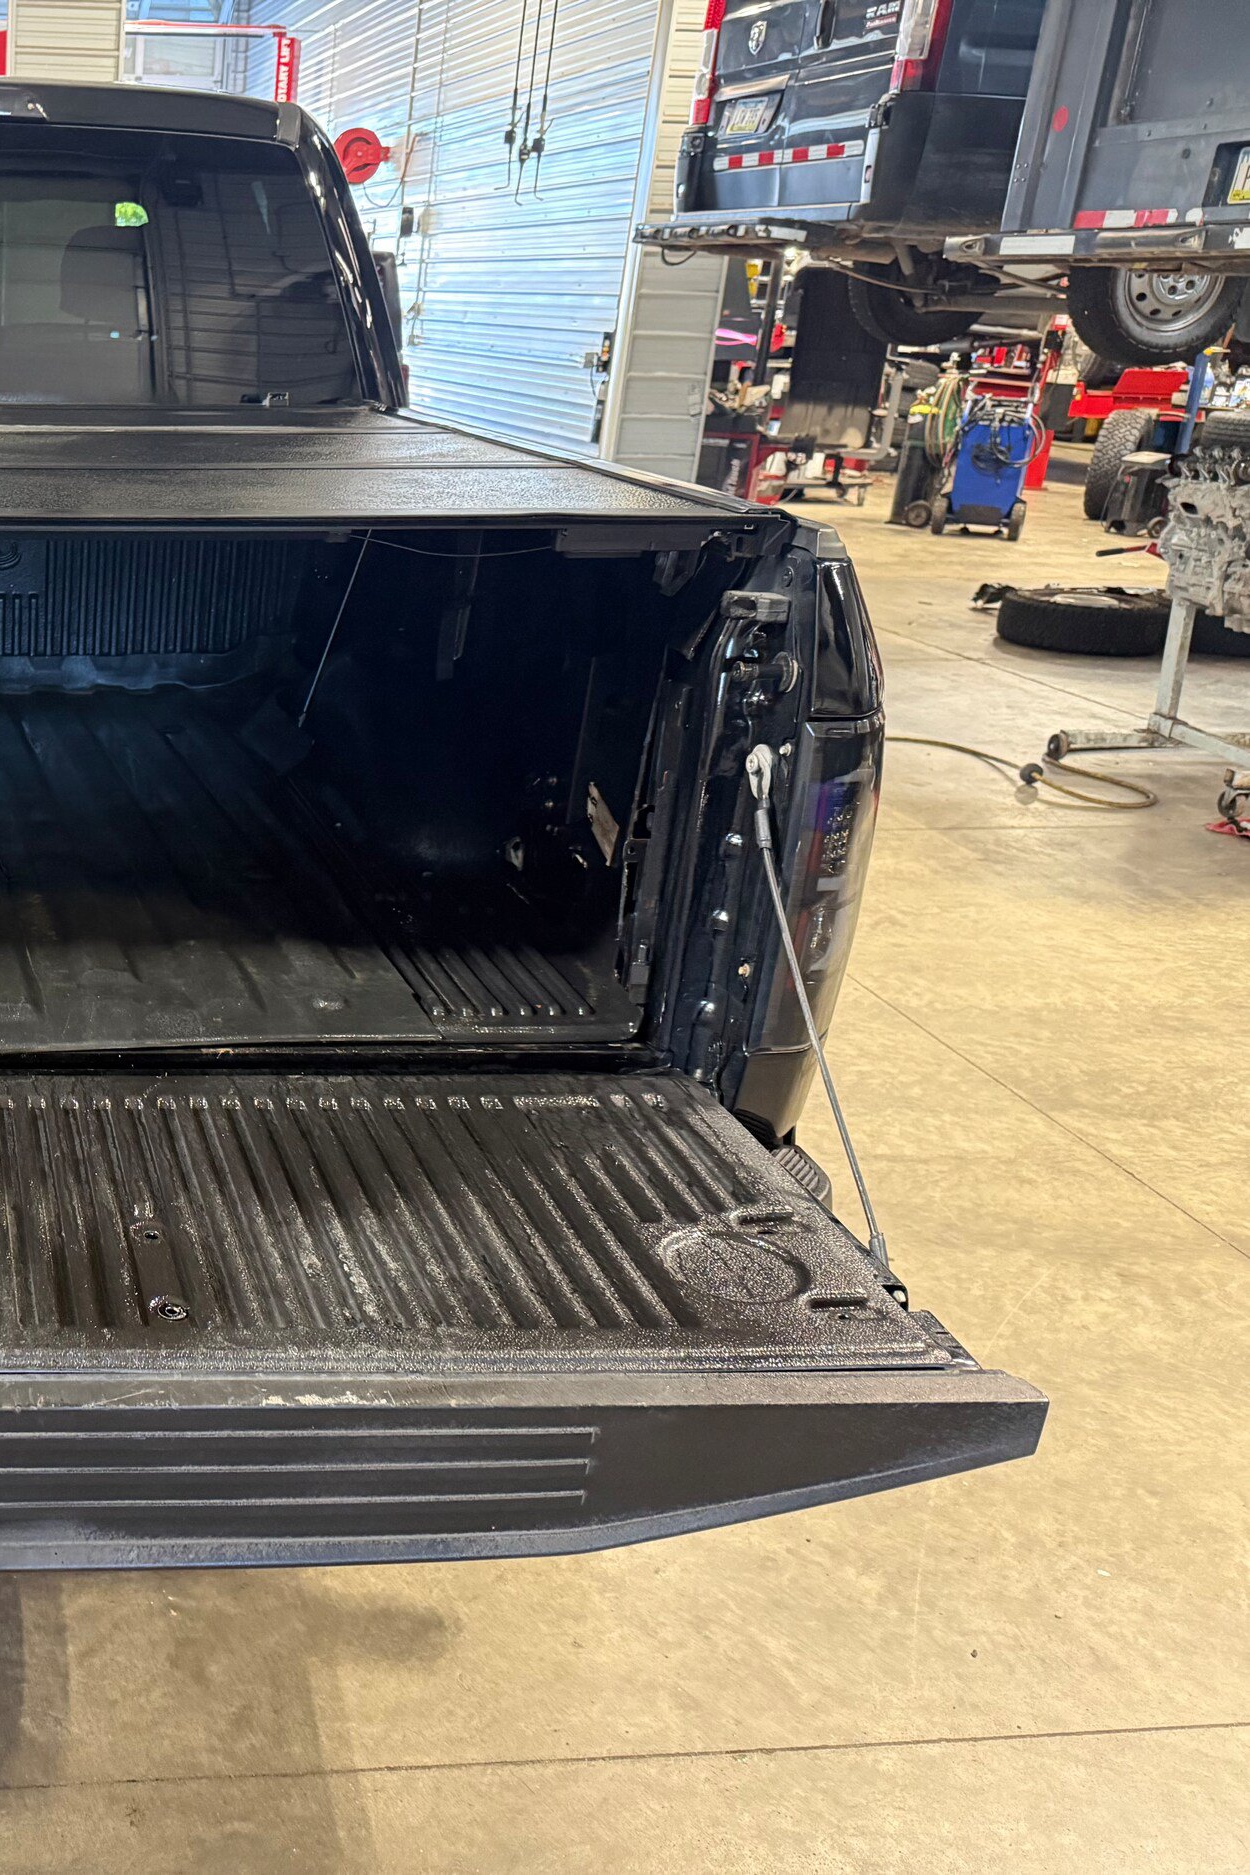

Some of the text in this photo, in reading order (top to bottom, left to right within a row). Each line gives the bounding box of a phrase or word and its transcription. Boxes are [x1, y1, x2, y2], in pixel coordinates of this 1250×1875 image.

[865, 1, 901, 19] RAM
[276, 38, 292, 102] OTARY LIFT
